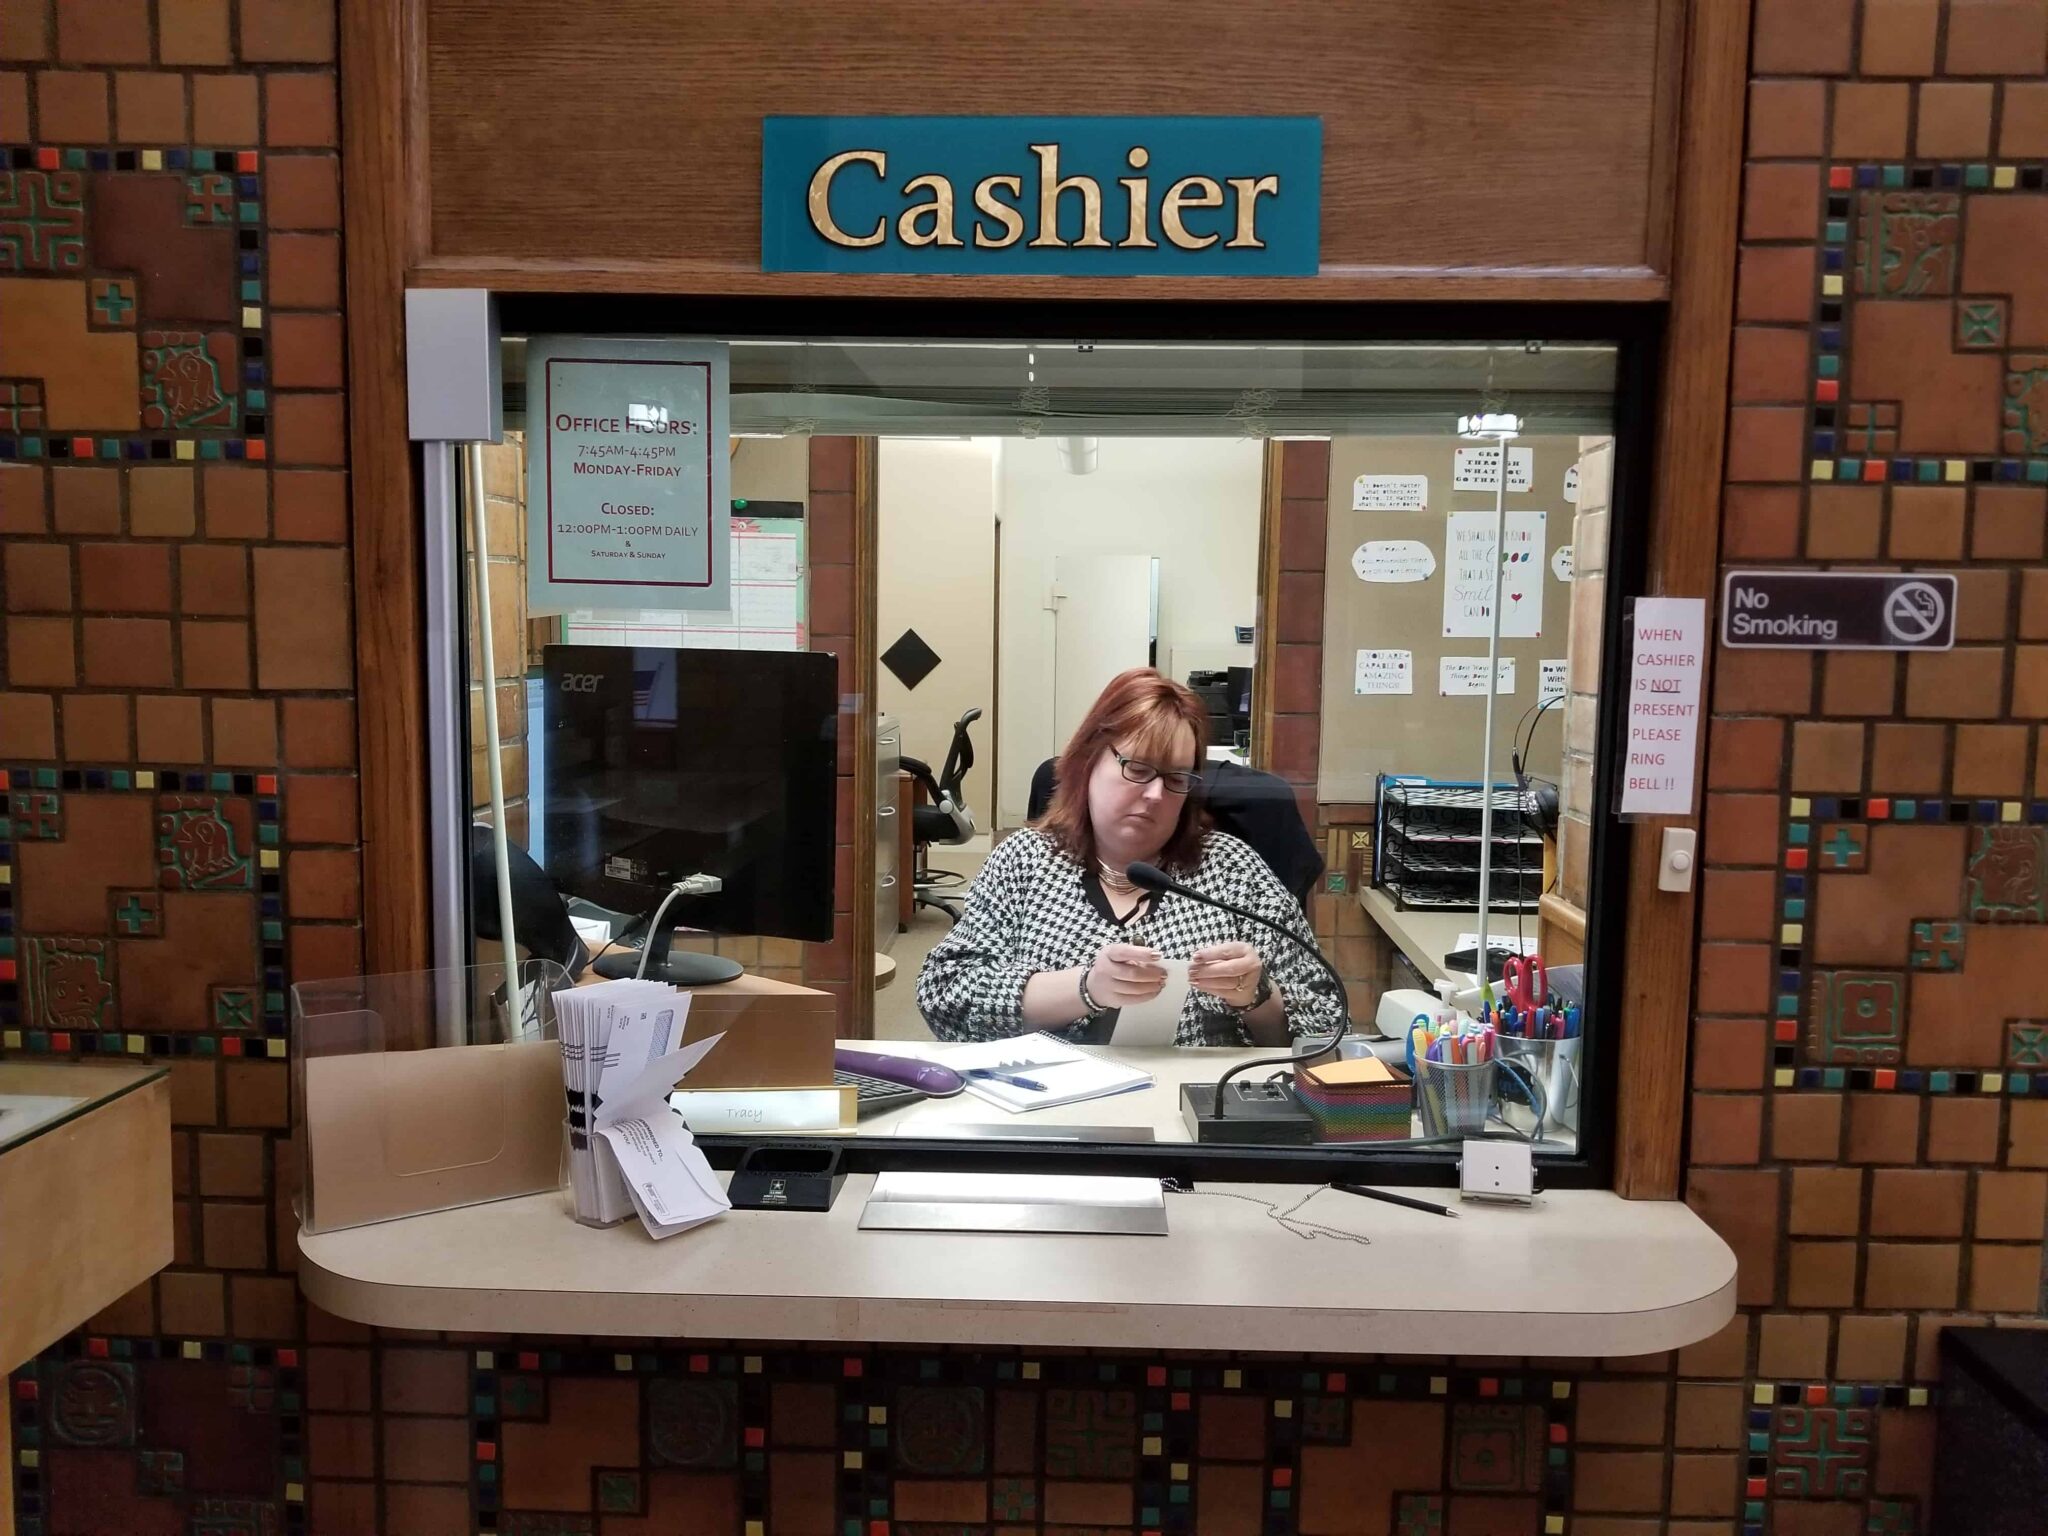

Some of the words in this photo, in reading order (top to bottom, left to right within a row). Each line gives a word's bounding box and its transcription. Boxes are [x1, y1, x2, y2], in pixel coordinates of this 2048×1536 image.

[808, 143, 1279, 250] Cashier
[555, 414, 620, 432] OFFICE
[578, 445, 676, 459] 7:45AM-4:45PM
[573, 462, 682, 477] MONDAY-FRIDAY
[601, 502, 655, 516] CLOSED:
[557, 524, 662, 536] 12:00PM-1:00PM
[665, 526, 698, 537] DAILY
[591, 550, 628, 558] SATURDAY
[637, 551, 666, 560] SUNDAY
[1455, 584, 1494, 601] Smil
[1735, 587, 1769, 608] No
[1733, 613, 1838, 640] Smoking
[1638, 628, 1683, 641] WHEN
[1636, 654, 1695, 666] CASHIER
[561, 673, 604, 693] acer
[1635, 679, 1647, 691] IS
[1651, 679, 1681, 692] NOT
[1633, 704, 1695, 716] PRESENT
[1632, 728, 1681, 741] PLEASE
[1631, 753, 1665, 766] RING
[1629, 778, 1659, 790] BELL
[1665, 778, 1675, 790] !!
[726, 1108, 763, 1122] Tracy
